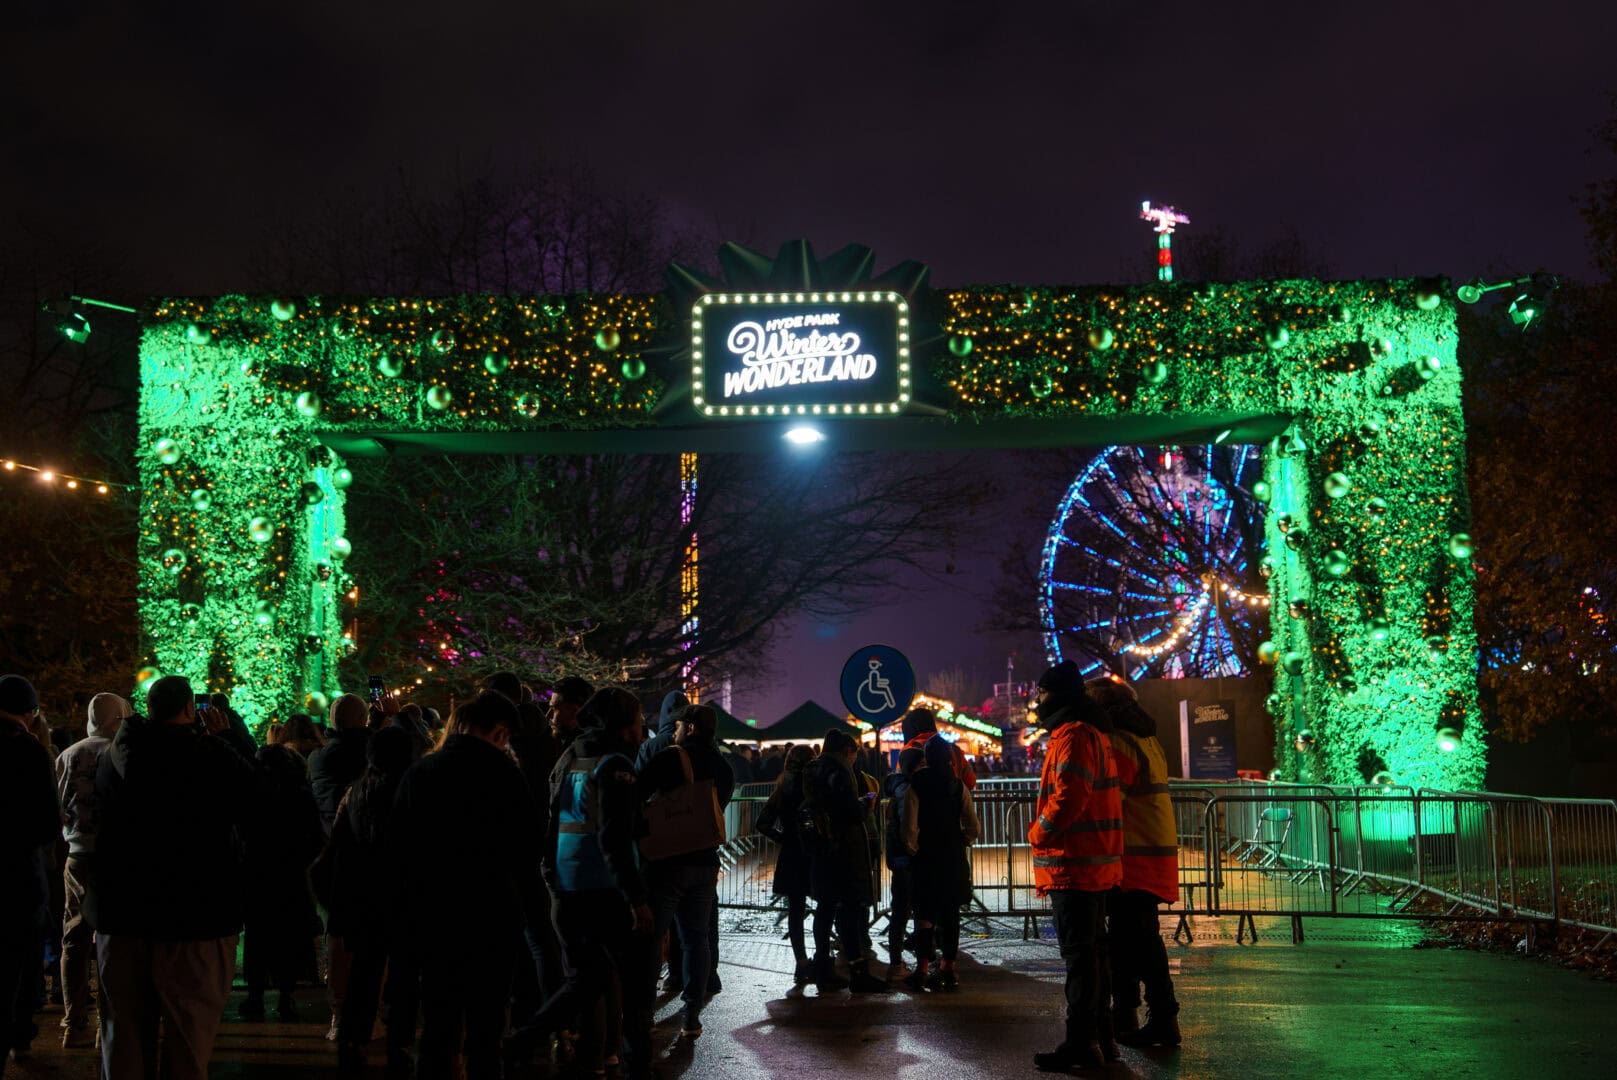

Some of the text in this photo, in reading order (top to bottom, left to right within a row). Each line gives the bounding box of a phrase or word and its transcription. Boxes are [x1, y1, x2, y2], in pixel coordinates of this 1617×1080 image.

[727, 321, 860, 366] Winter
[766, 313, 840, 331] HYDE PARK
[724, 354, 876, 398] WONDERLAND
